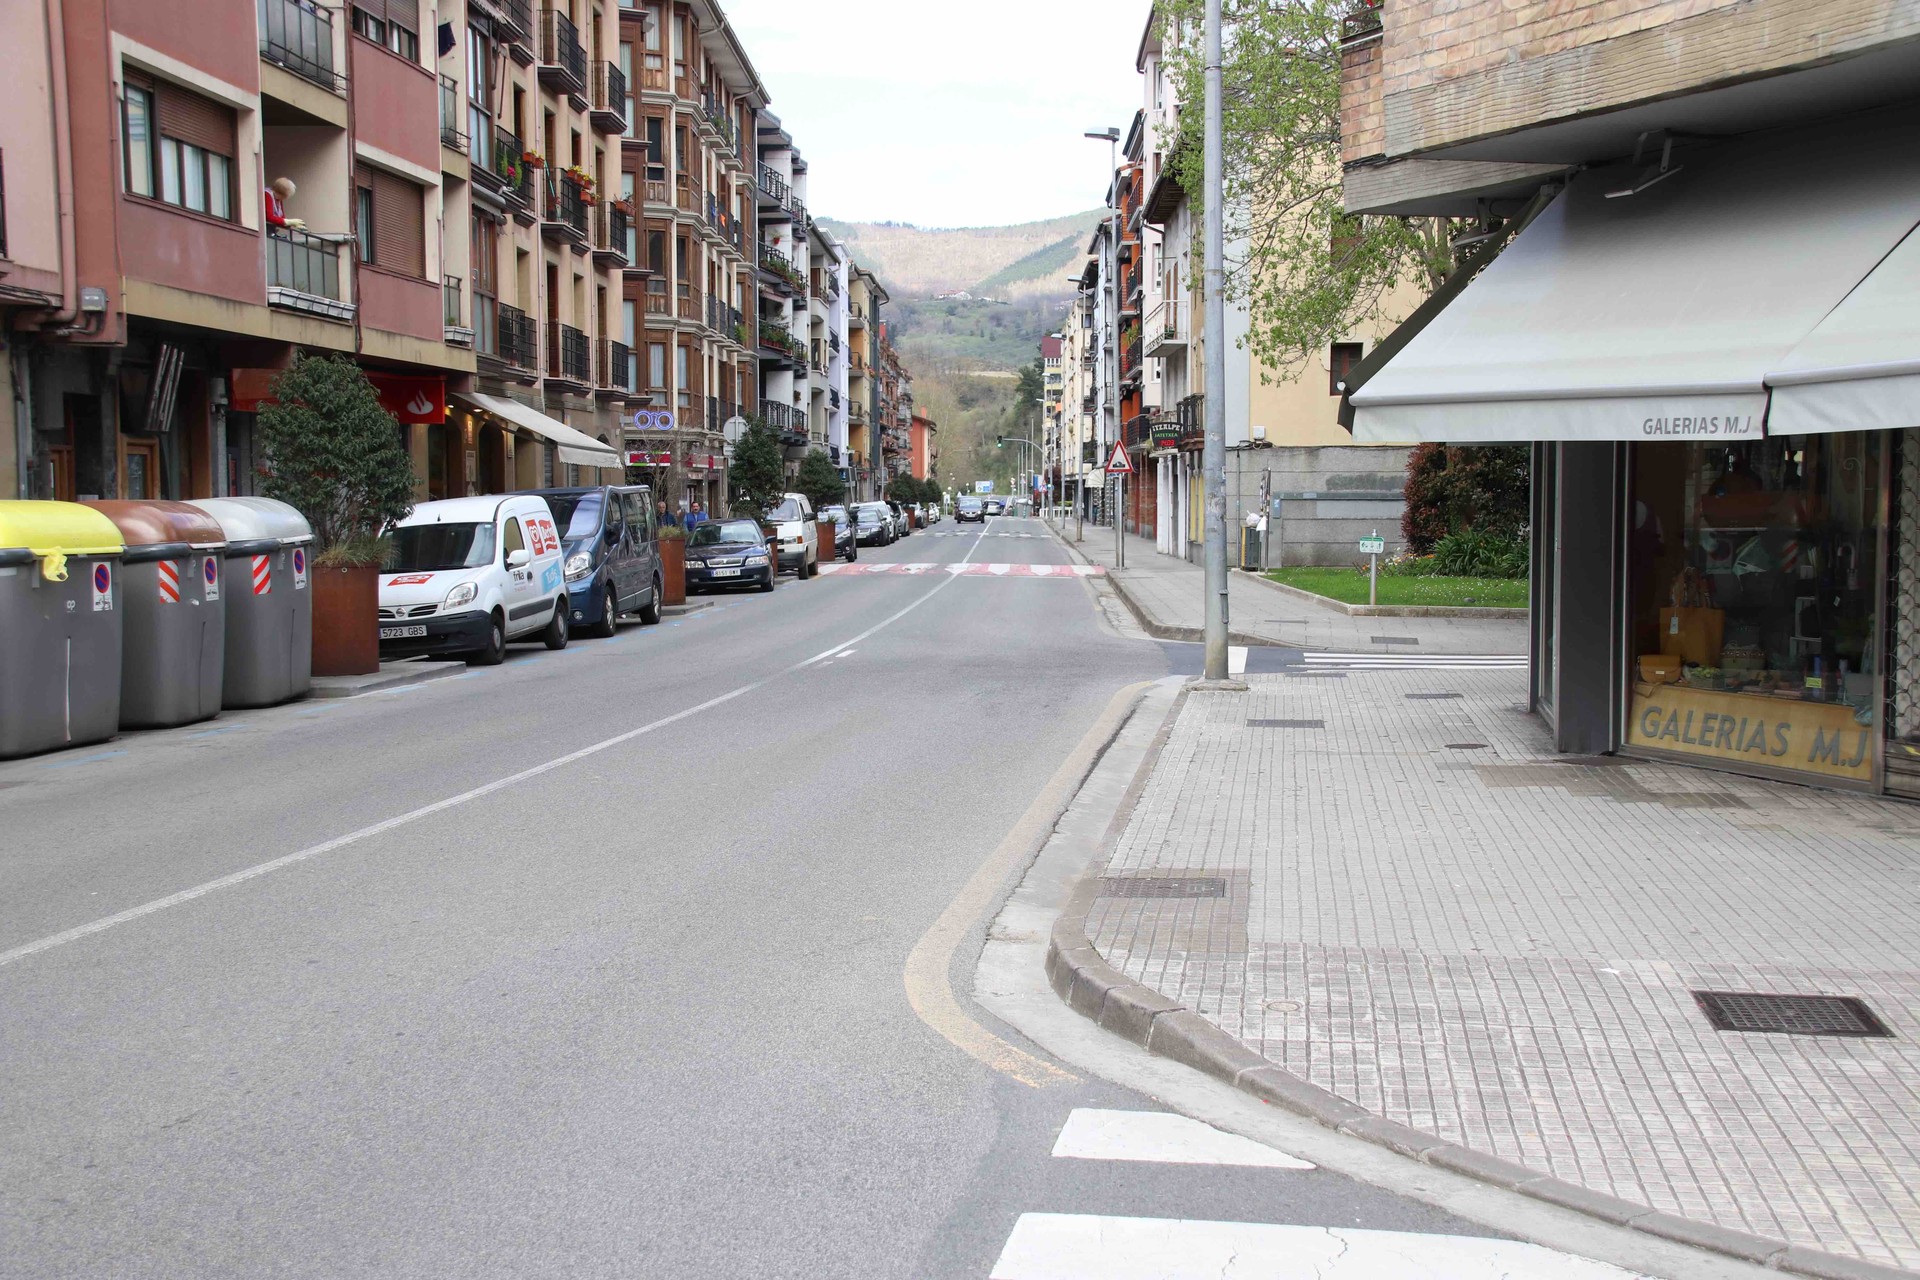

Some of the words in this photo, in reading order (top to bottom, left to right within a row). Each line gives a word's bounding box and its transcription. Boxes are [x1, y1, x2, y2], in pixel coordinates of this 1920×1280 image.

[1642, 417, 1719, 435] GALERIAS
[382, 628, 404, 638] 5723
[408, 626, 424, 636] GBS
[1640, 706, 1792, 757] GALERIAS
